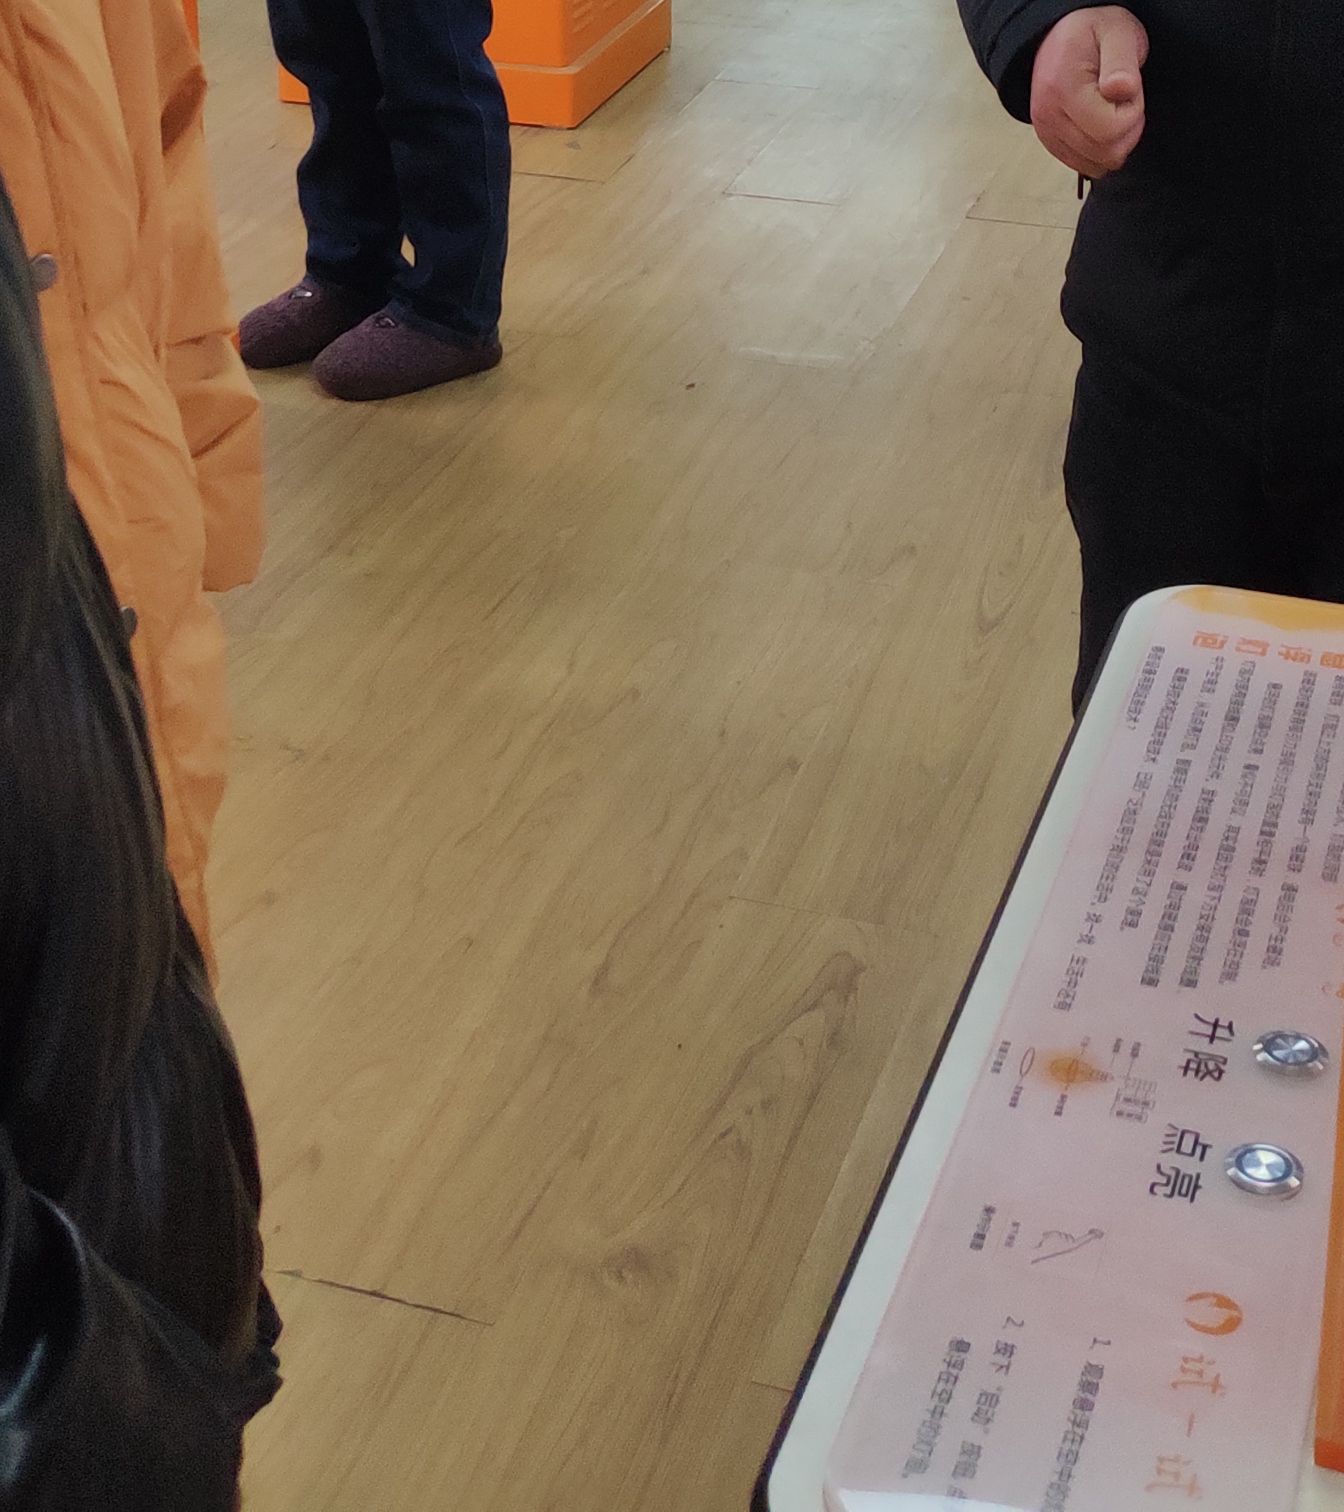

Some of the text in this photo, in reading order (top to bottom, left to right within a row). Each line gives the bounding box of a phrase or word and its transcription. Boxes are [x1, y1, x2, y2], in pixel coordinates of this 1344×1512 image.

[1176, 1011, 1236, 1084] 升降
[1148, 1122, 1216, 1205] 点亮
[1143, 1353, 1227, 1499] 试一试
